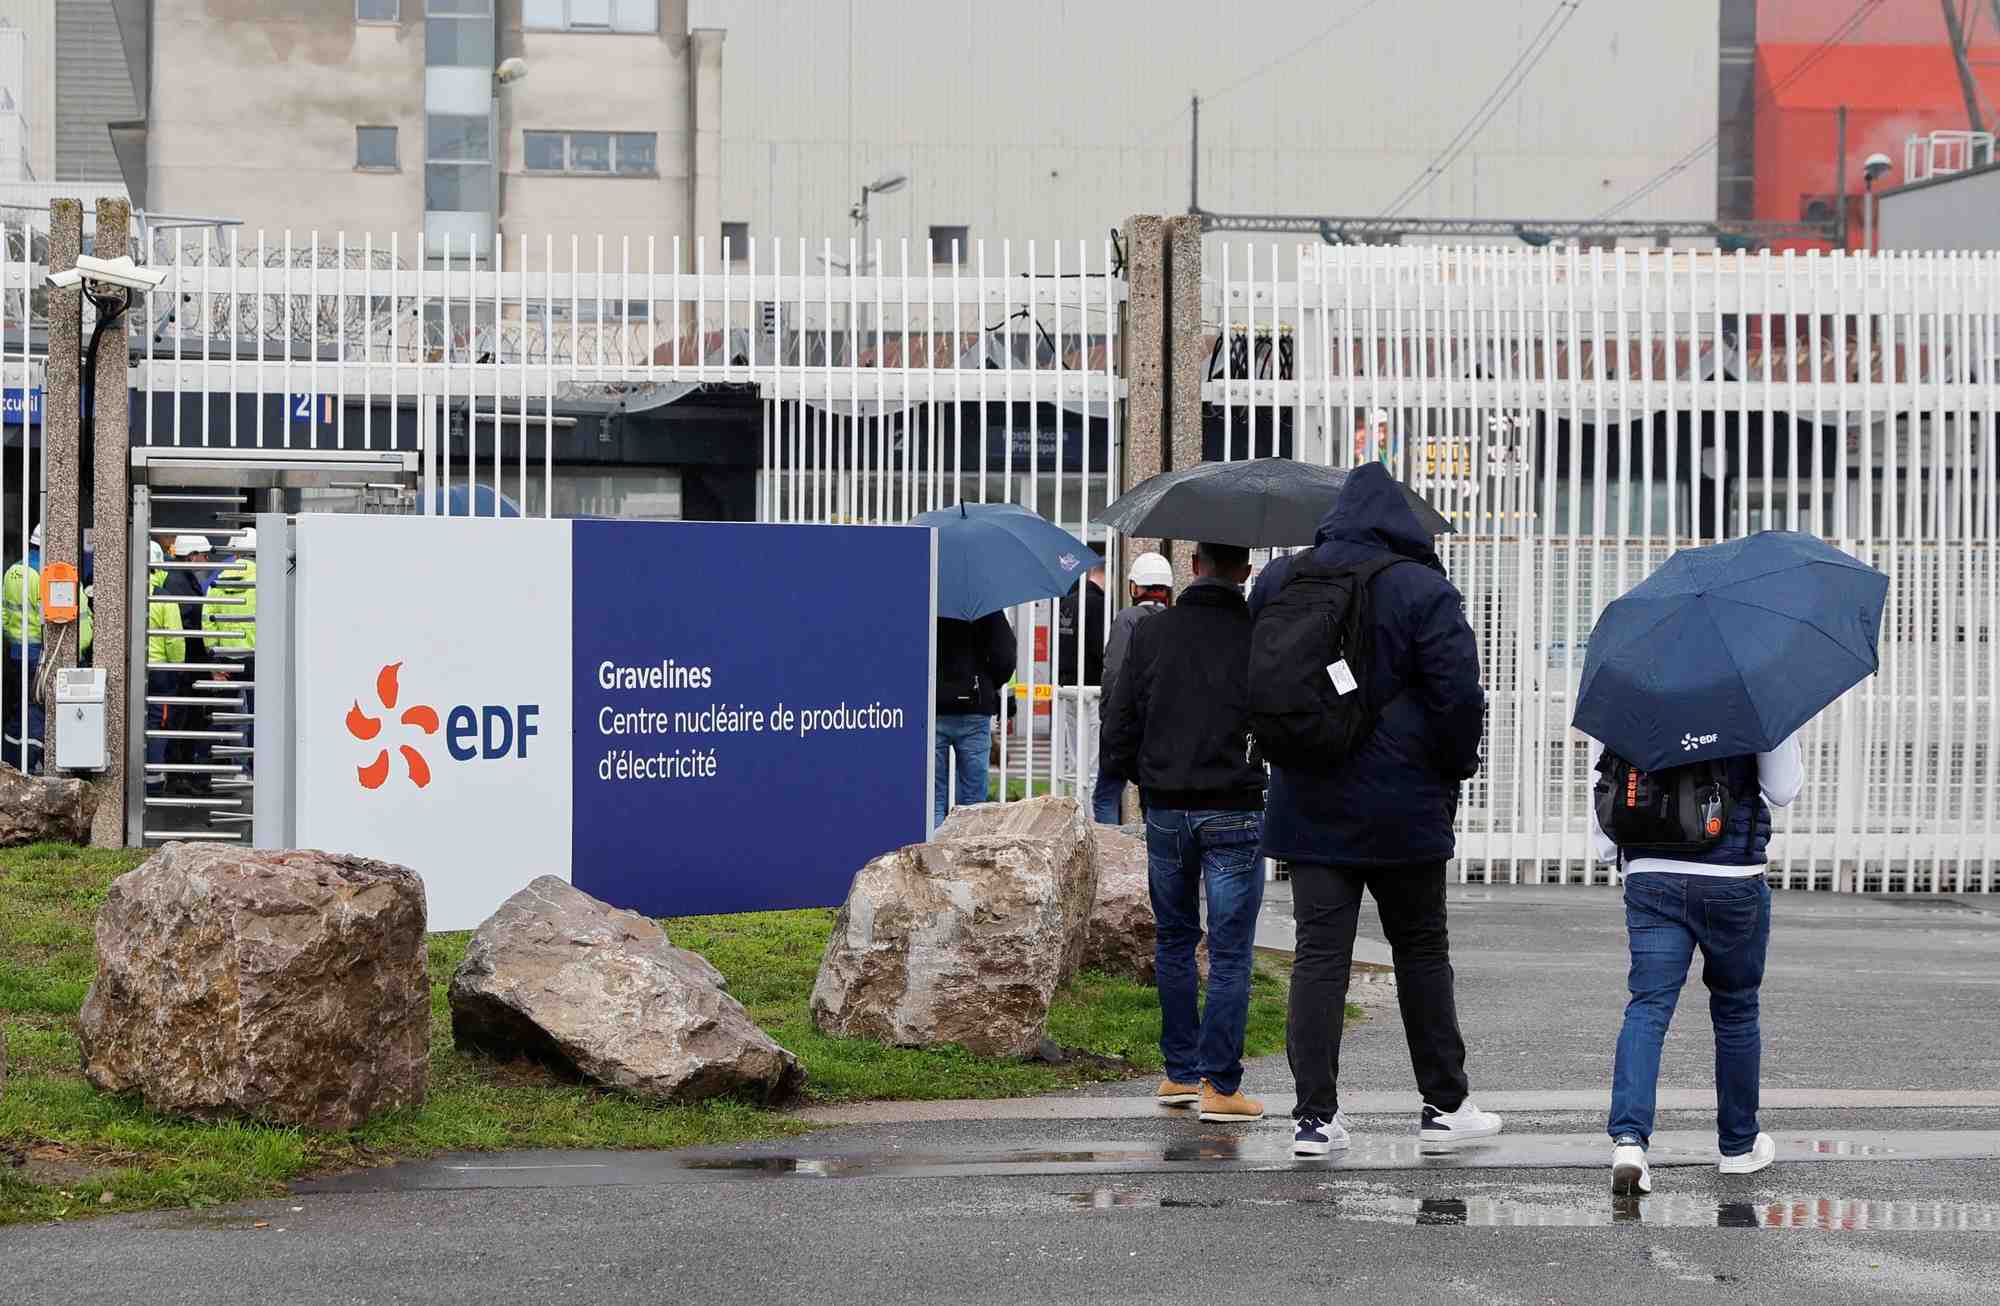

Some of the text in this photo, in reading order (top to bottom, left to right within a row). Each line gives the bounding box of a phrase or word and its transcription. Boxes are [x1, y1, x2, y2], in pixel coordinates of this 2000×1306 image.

[296, 392, 310, 417] 2
[599, 659, 712, 690] Gravelines
[599, 702, 904, 738] Centre nucléaire de production
[599, 748, 717, 780] d’électricité
